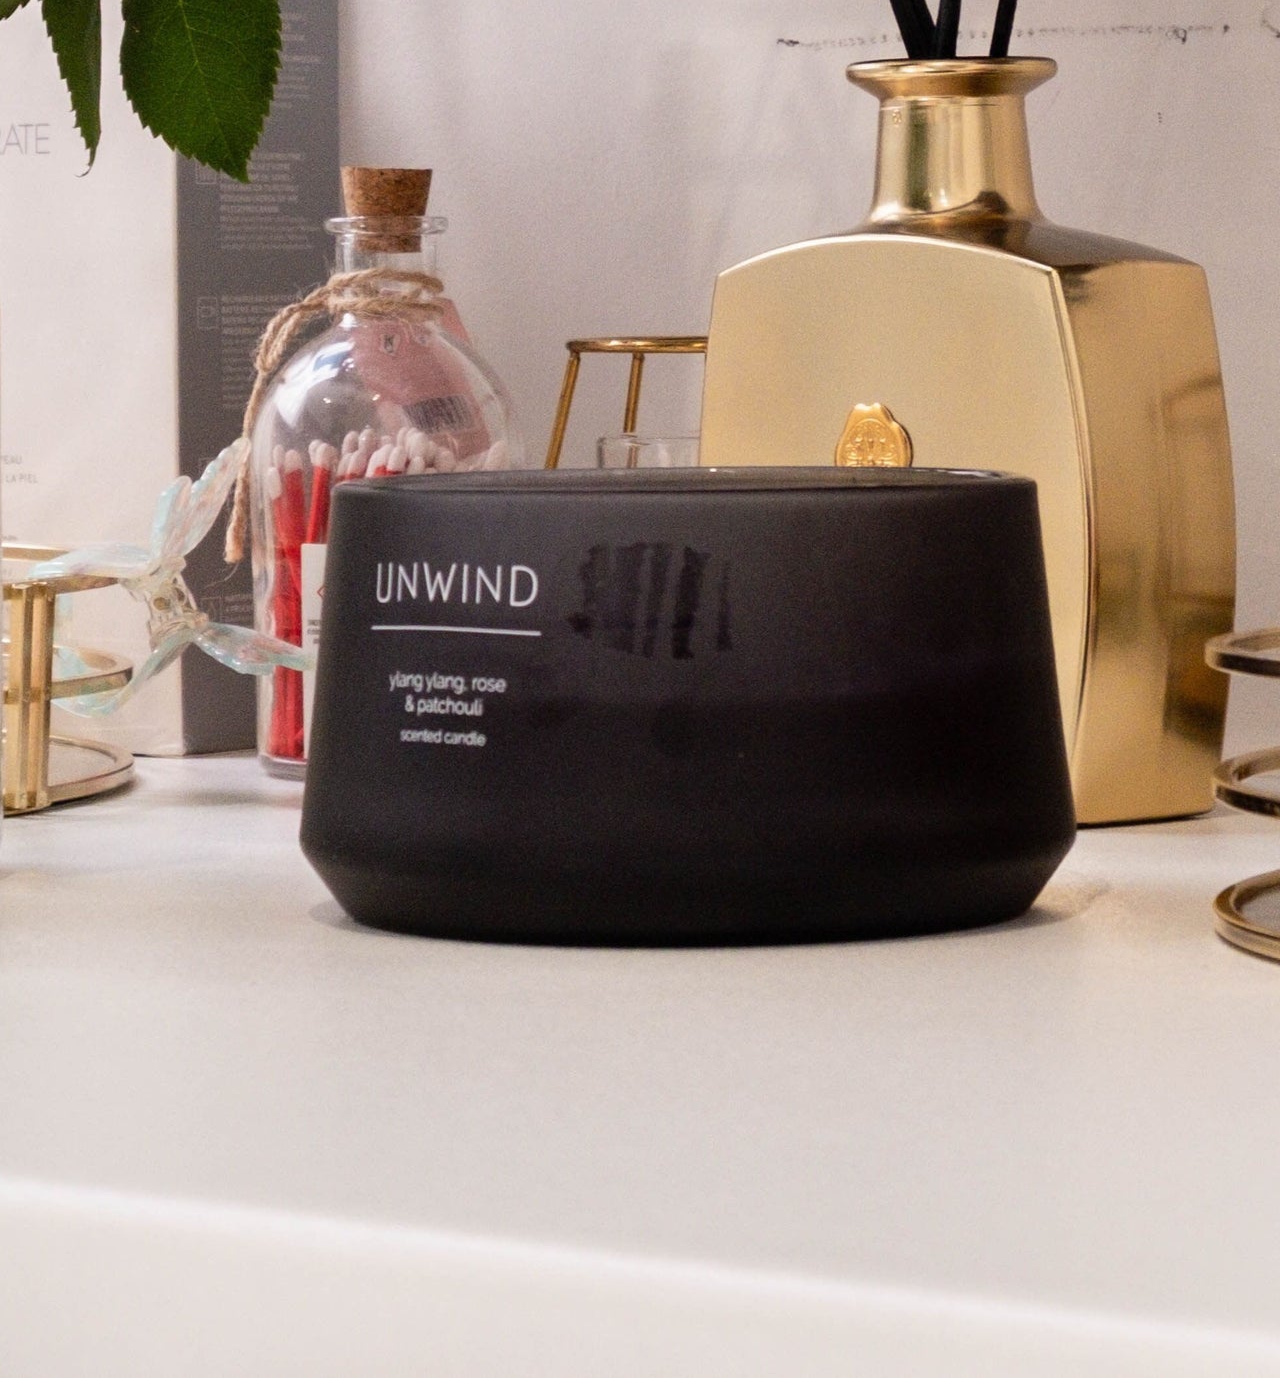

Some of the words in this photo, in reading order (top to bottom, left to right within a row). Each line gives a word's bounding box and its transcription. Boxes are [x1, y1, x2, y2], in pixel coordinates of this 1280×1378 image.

[375, 561, 540, 608] UNWIND
[388, 670, 423, 692] ylang
[471, 677, 508, 694] rose
[404, 693, 415, 713] &
[416, 694, 485, 717] patchouli
[399, 728, 443, 745] scented
[443, 730, 488, 748] candle
